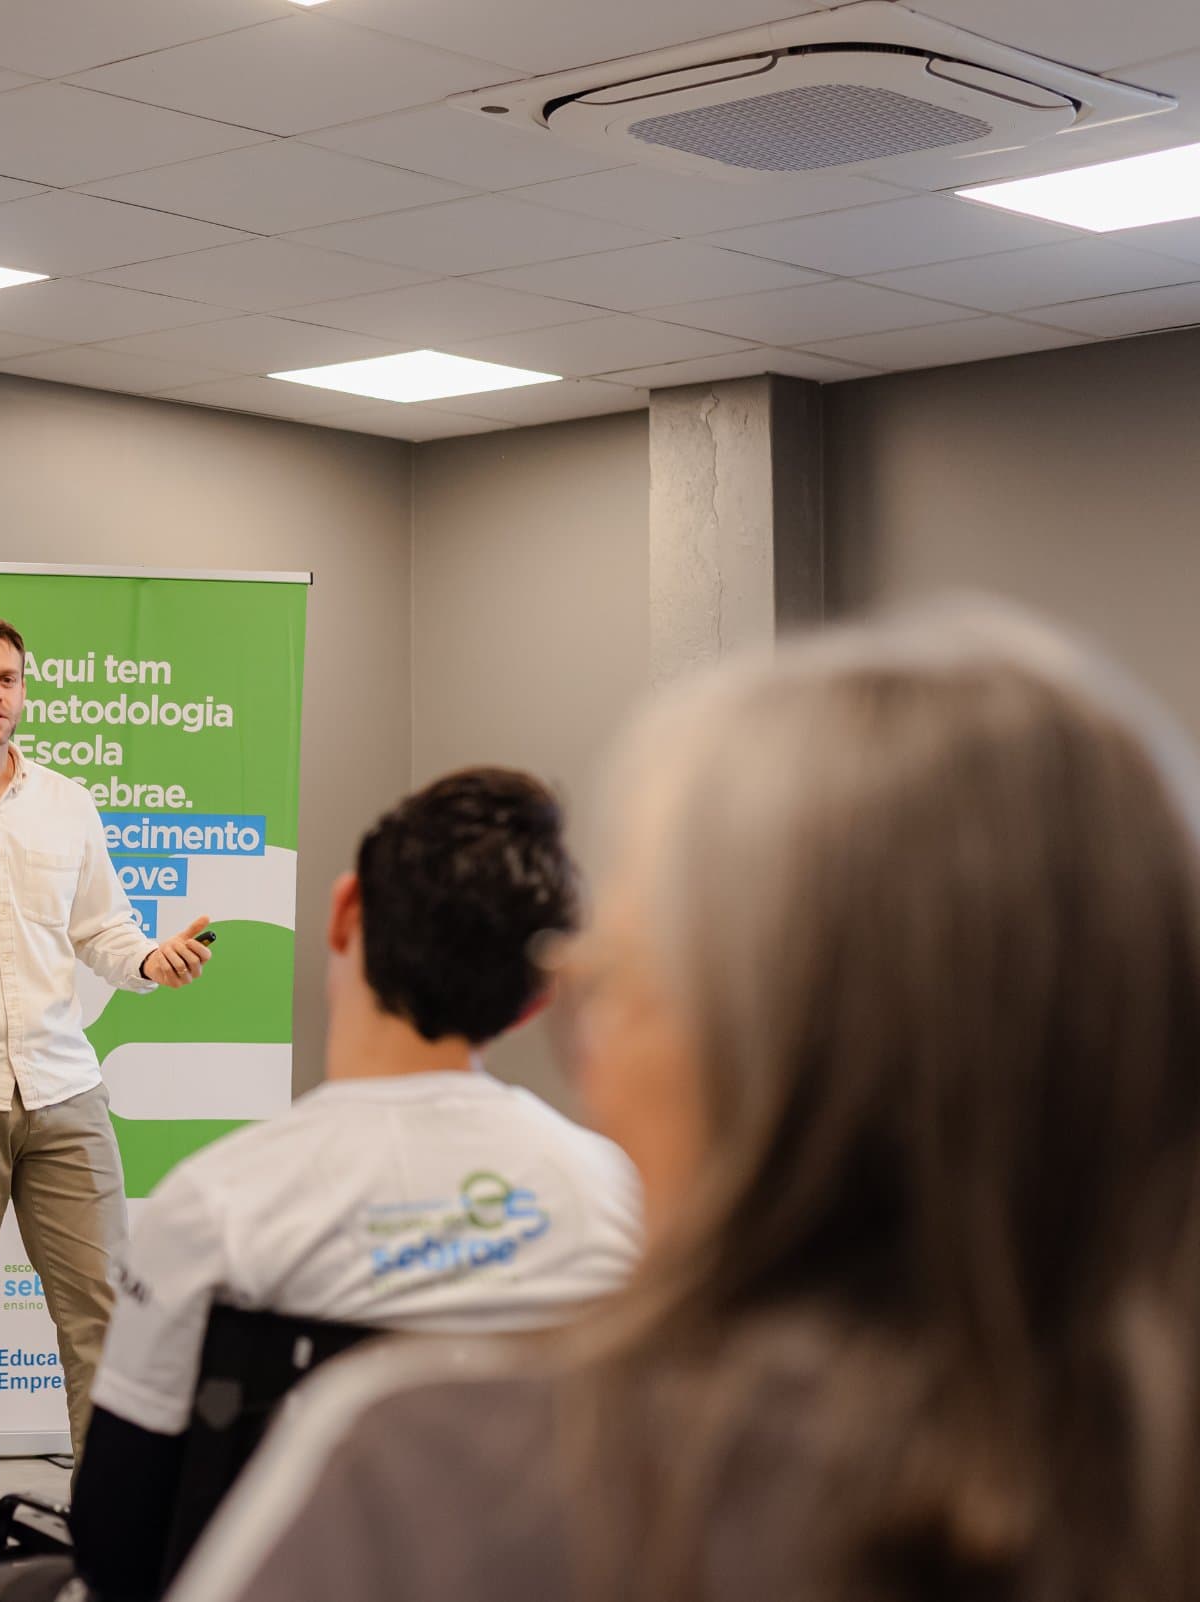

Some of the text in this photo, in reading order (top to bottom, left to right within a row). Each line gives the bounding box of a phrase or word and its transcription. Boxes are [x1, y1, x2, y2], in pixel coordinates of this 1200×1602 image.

[22, 651, 172, 689] Aqui tem
[23, 693, 234, 733] metodologia
[13, 734, 123, 766] Escola
[104, 817, 260, 851] ecimento
[117, 865, 179, 891] ove
[3, 1264, 35, 1273] esco
[3, 1274, 46, 1297] seb
[3, 1301, 44, 1310] ensino
